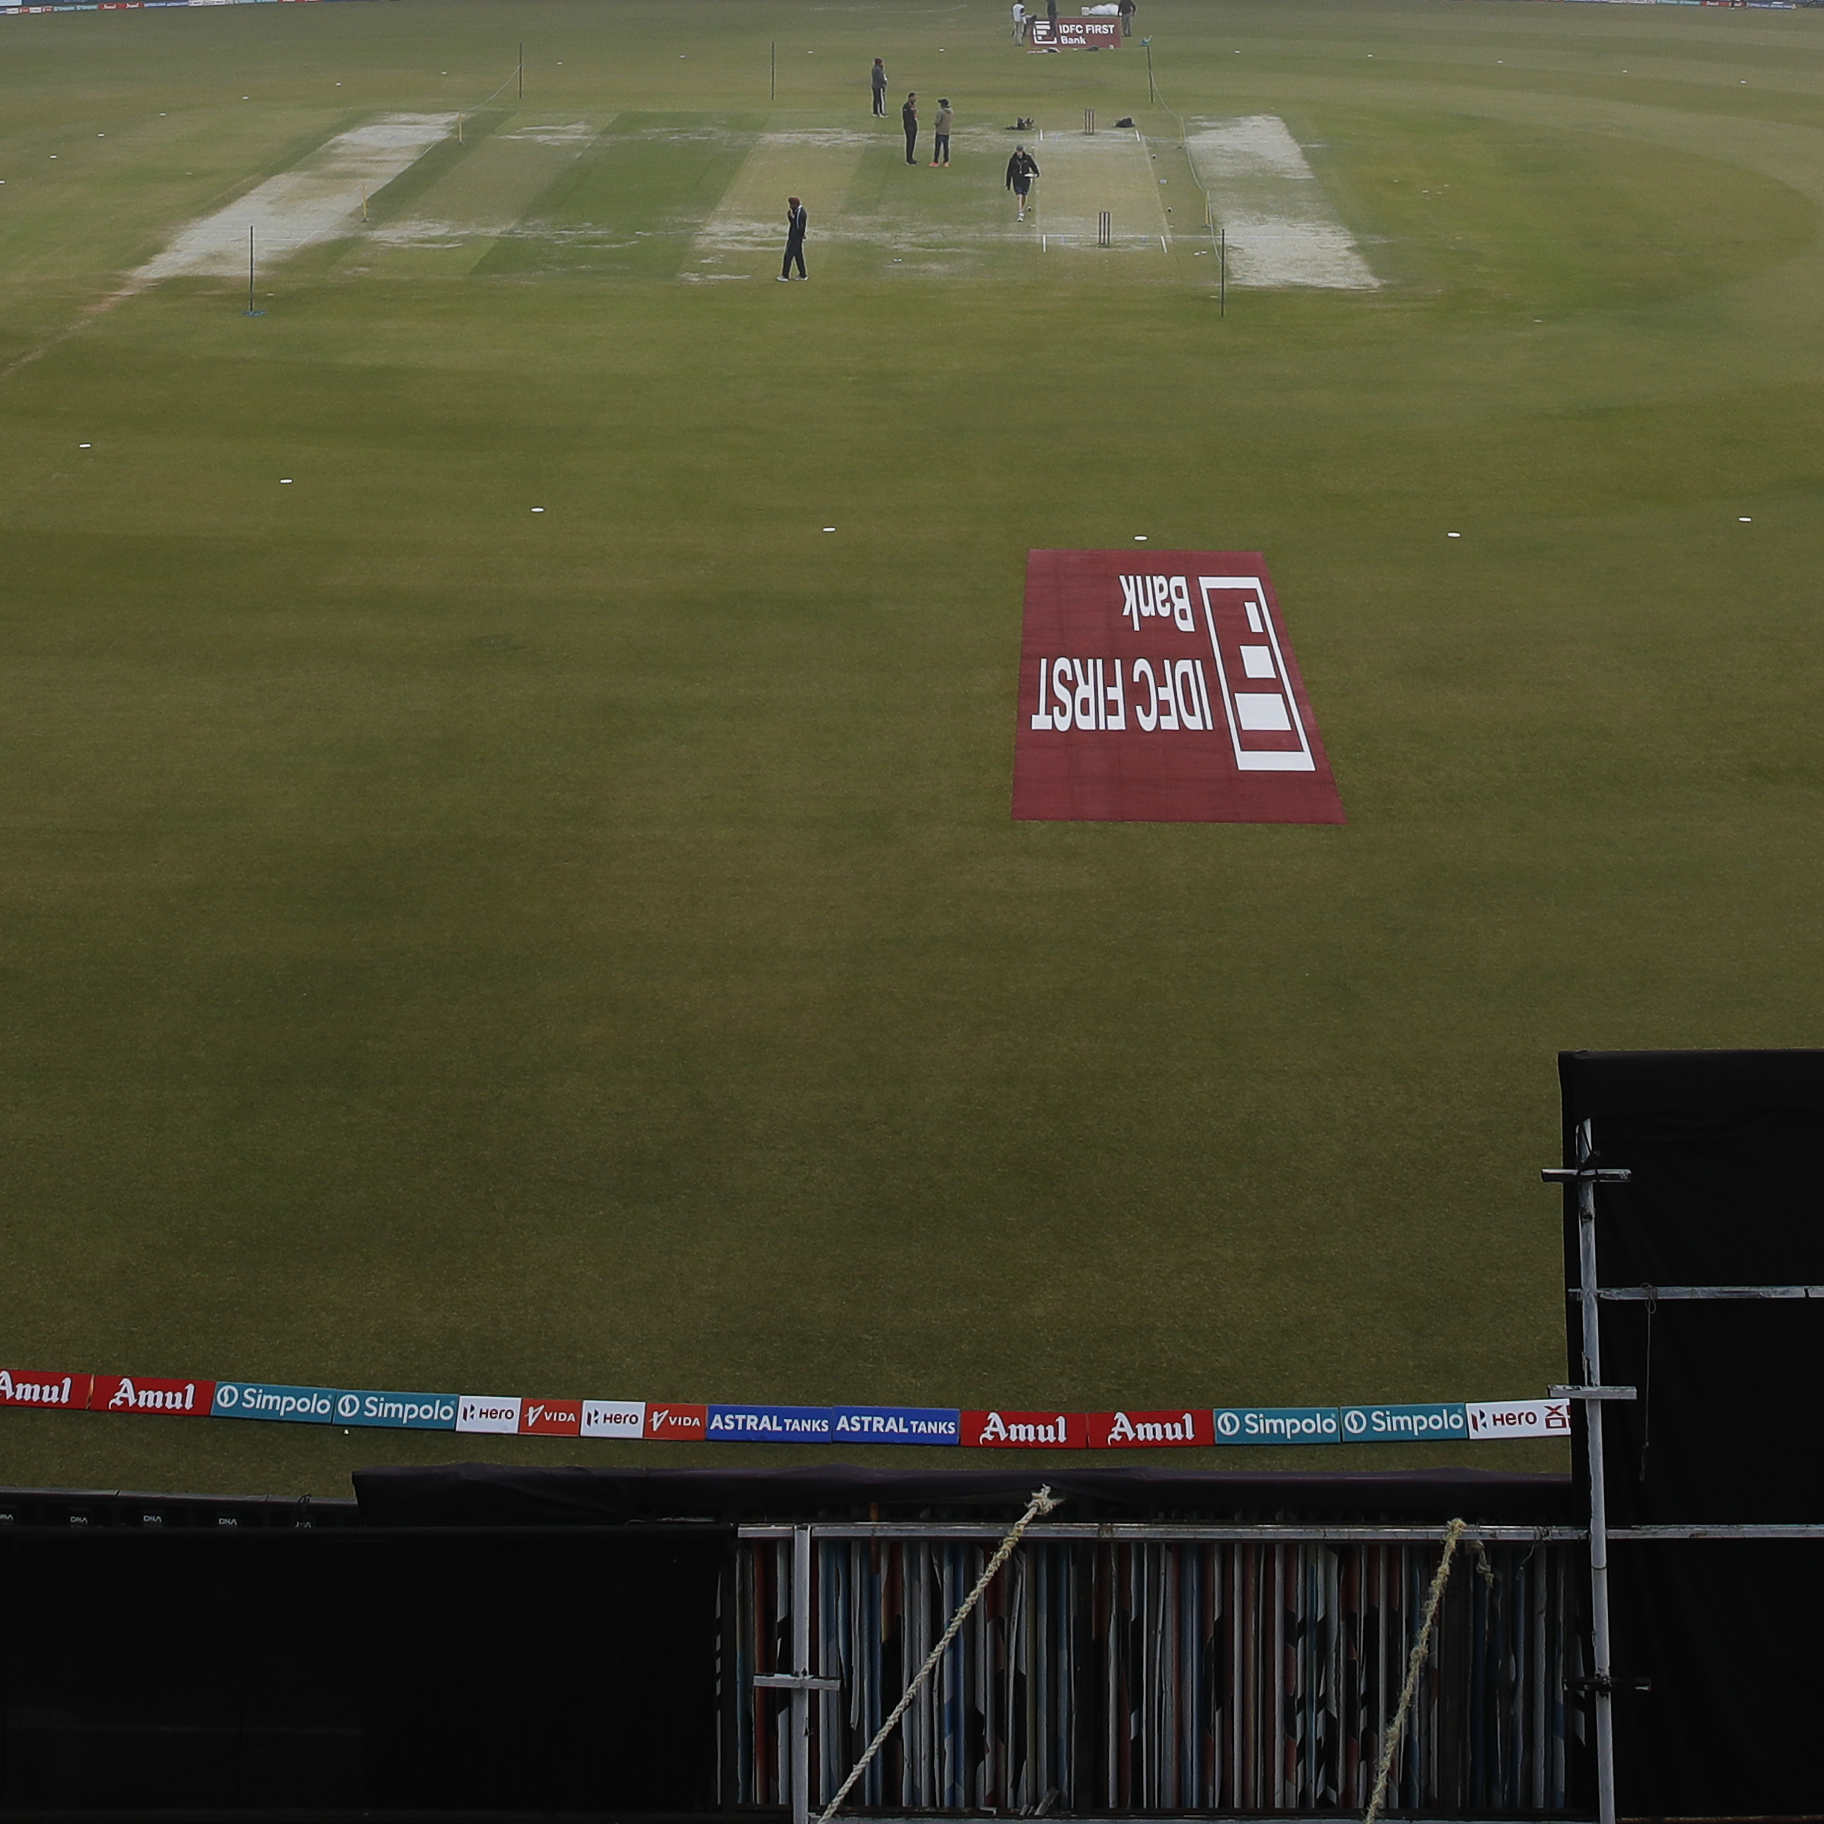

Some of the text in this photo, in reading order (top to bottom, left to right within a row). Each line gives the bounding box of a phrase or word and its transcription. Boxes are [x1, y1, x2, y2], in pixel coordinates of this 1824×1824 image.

[1059, 24, 1115, 35] IDFC FIRST
[1060, 35, 1087, 45] Bank
[1119, 575, 1195, 631] Bank
[1031, 657, 1213, 732] IDFC FIRST
[109, 1377, 195, 1411] Amul
[241, 1388, 331, 1416] Simpolo
[479, 1406, 515, 1421] Hero
[544, 1411, 576, 1423] VIDA
[710, 1414, 829, 1433] ASTRAL TANKS
[1371, 1410, 1463, 1436] Simpolo
[1492, 1410, 1537, 1427] Hero
[979, 1412, 1066, 1445] Amul
